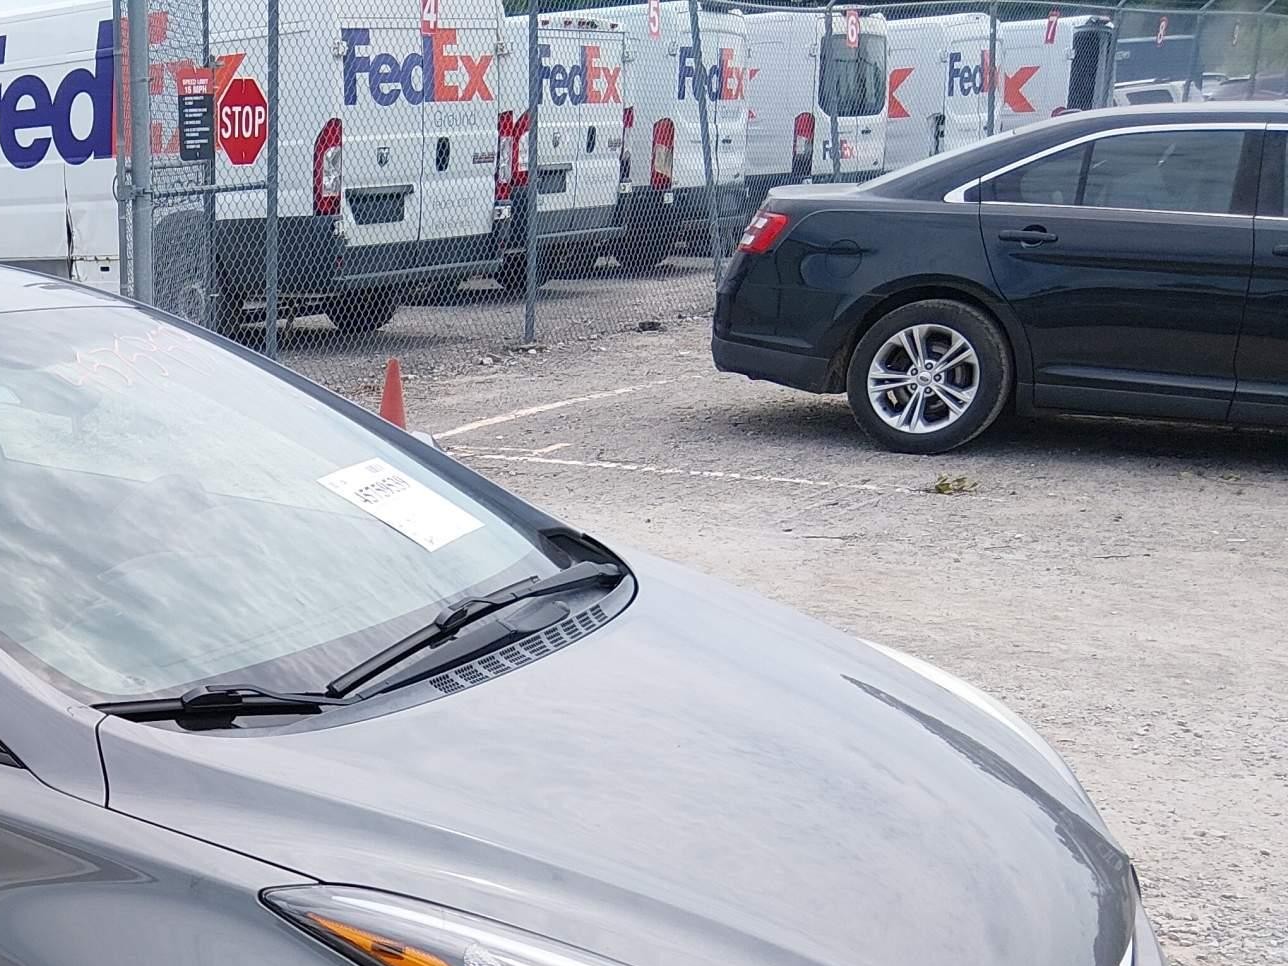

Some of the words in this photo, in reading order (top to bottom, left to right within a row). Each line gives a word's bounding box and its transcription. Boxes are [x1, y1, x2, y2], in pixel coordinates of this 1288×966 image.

[423, 0, 437, 29] 4
[649, 0, 659, 33] 5
[847, 14, 858, 43] 6
[1047, 16, 1058, 40] 7
[1157, 20, 1166, 44] 8
[341, 28, 494, 106] FedEx
[537, 44, 622, 106] FedEx
[185, 86, 192, 94] 15
[193, 86, 207, 94] MPH
[221, 106, 265, 139] STOP
[822, 139, 854, 160] FEx
